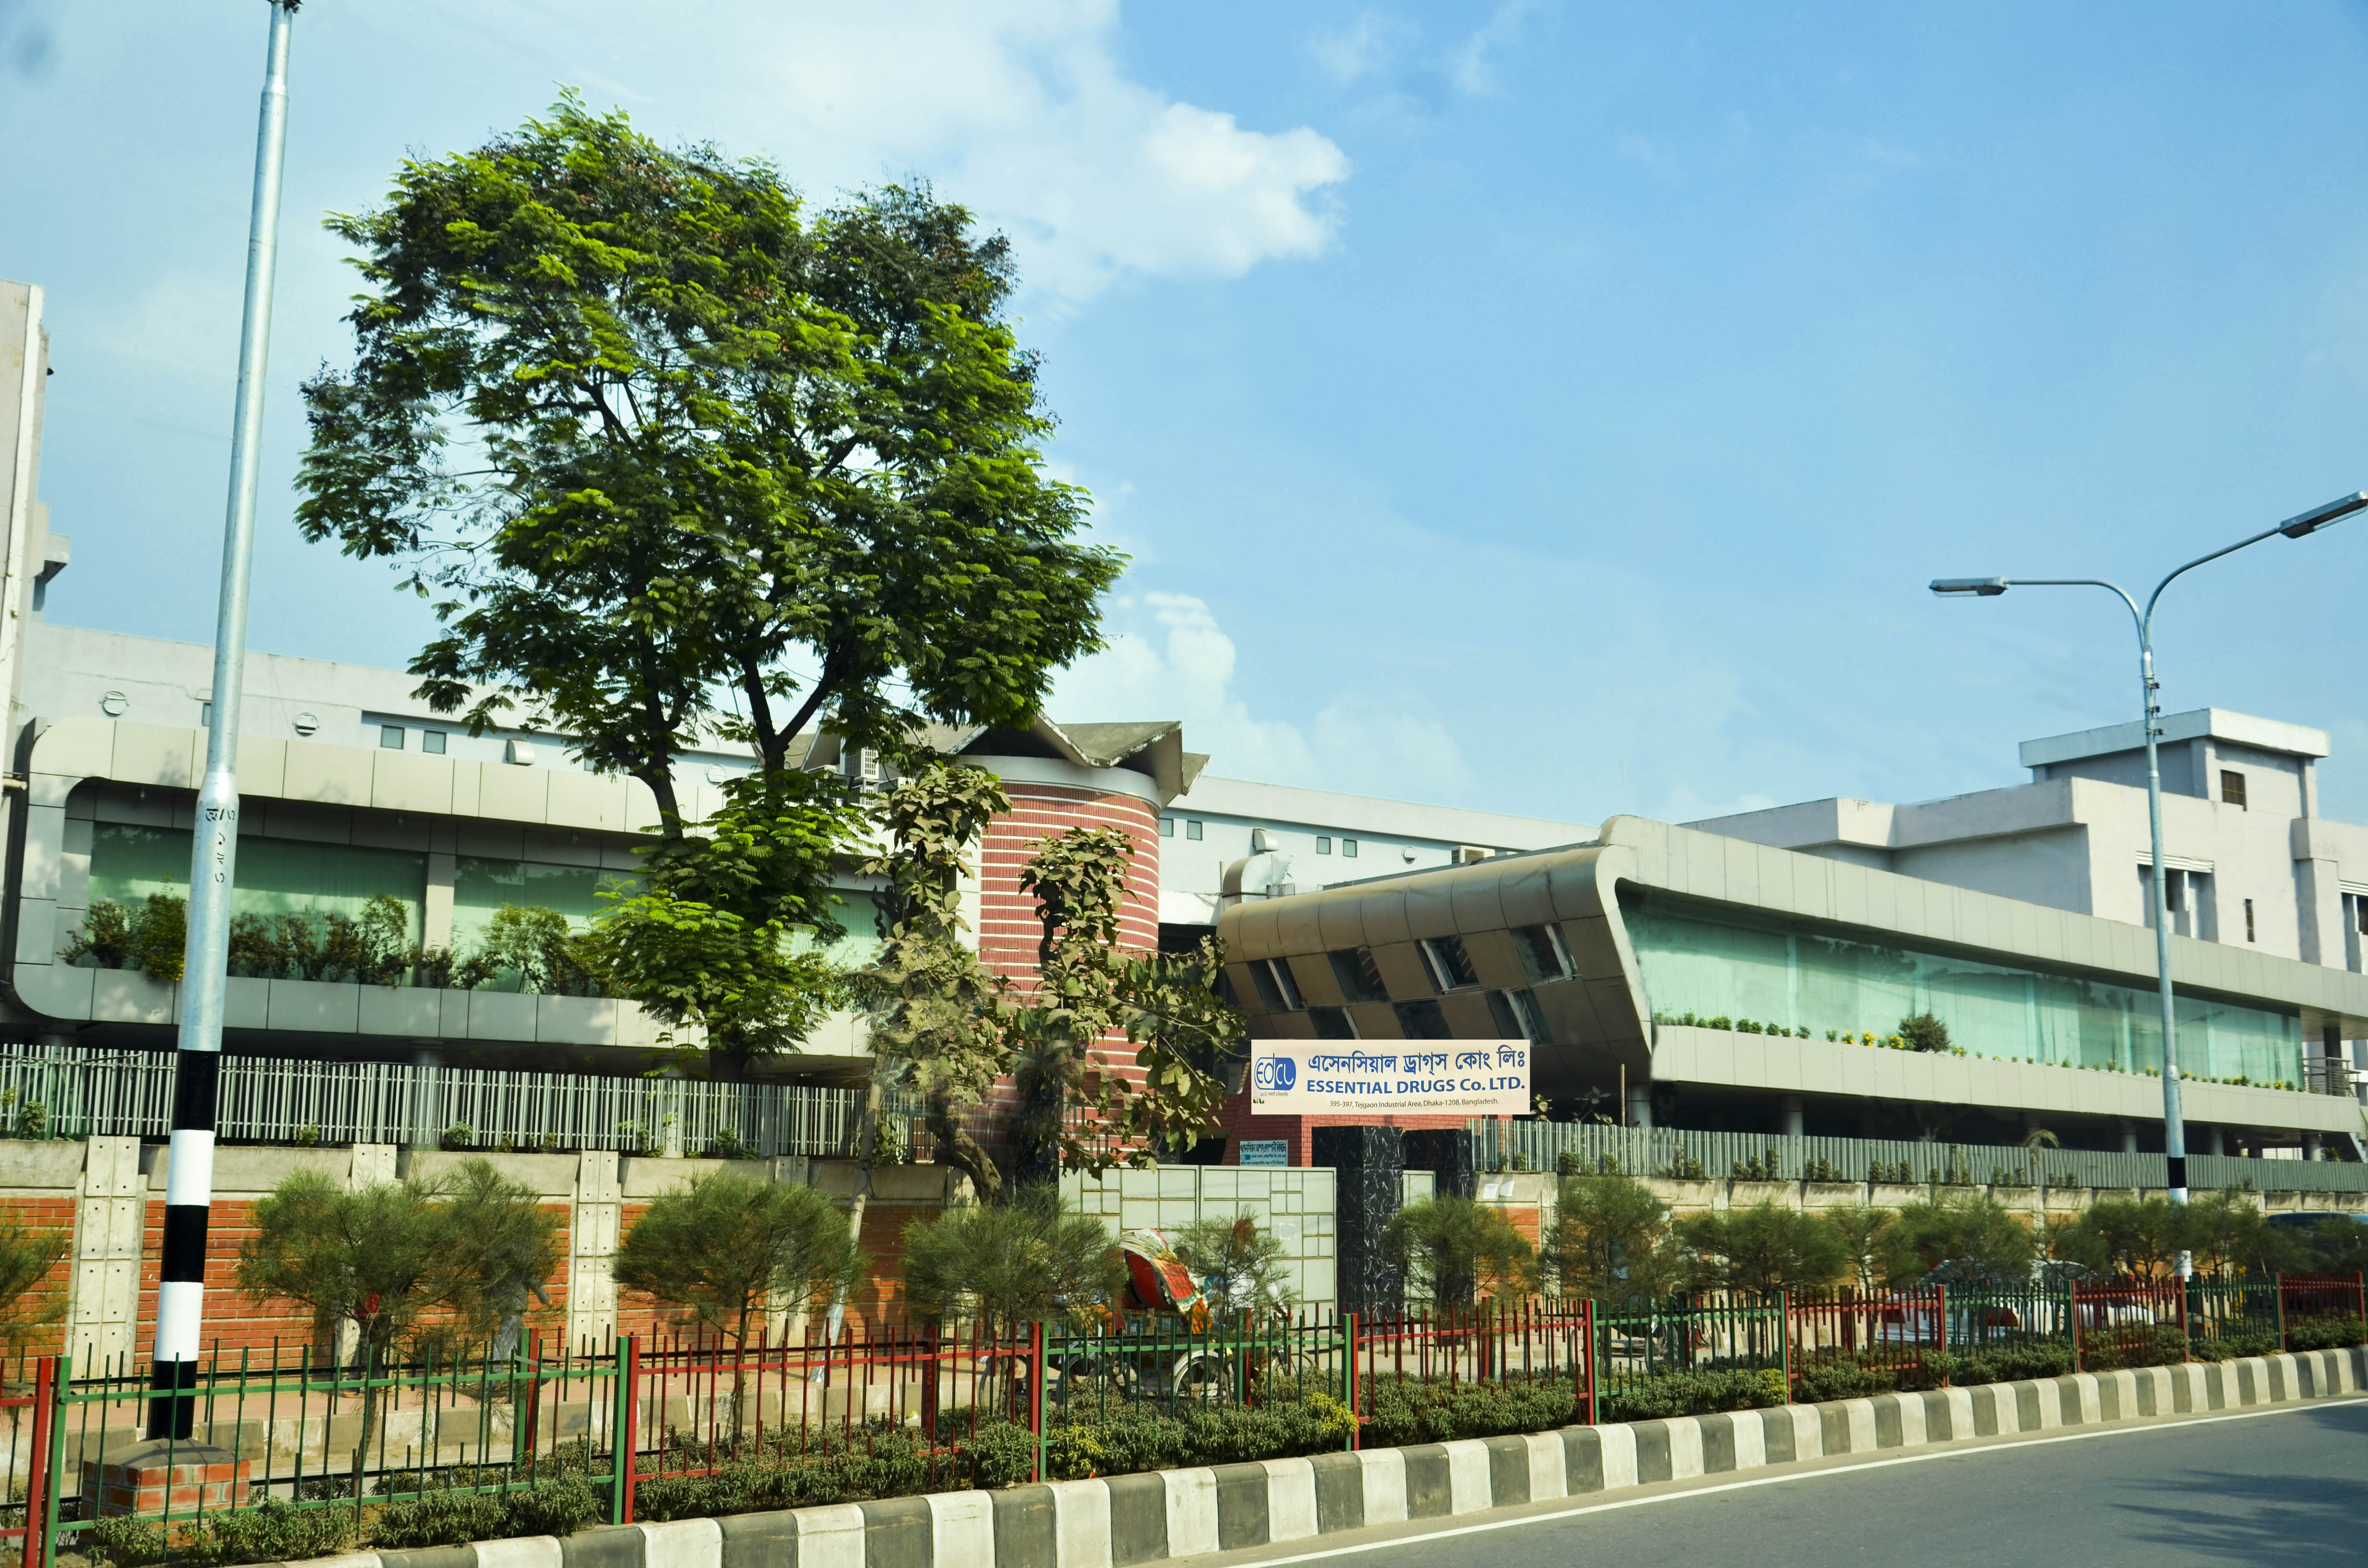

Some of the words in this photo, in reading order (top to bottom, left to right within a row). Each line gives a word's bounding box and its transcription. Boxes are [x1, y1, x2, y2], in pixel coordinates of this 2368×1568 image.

[1455, 1050, 1492, 1071] কোং
[1307, 1080, 1393, 1094] ESSENTIAL
[1397, 1079, 1455, 1093] DRUGS
[1490, 1077, 1525, 1090] LTD.
[1423, 1099, 1461, 1107] Dhaka-1208,
[1462, 1098, 1499, 1106] Bangladesh.
